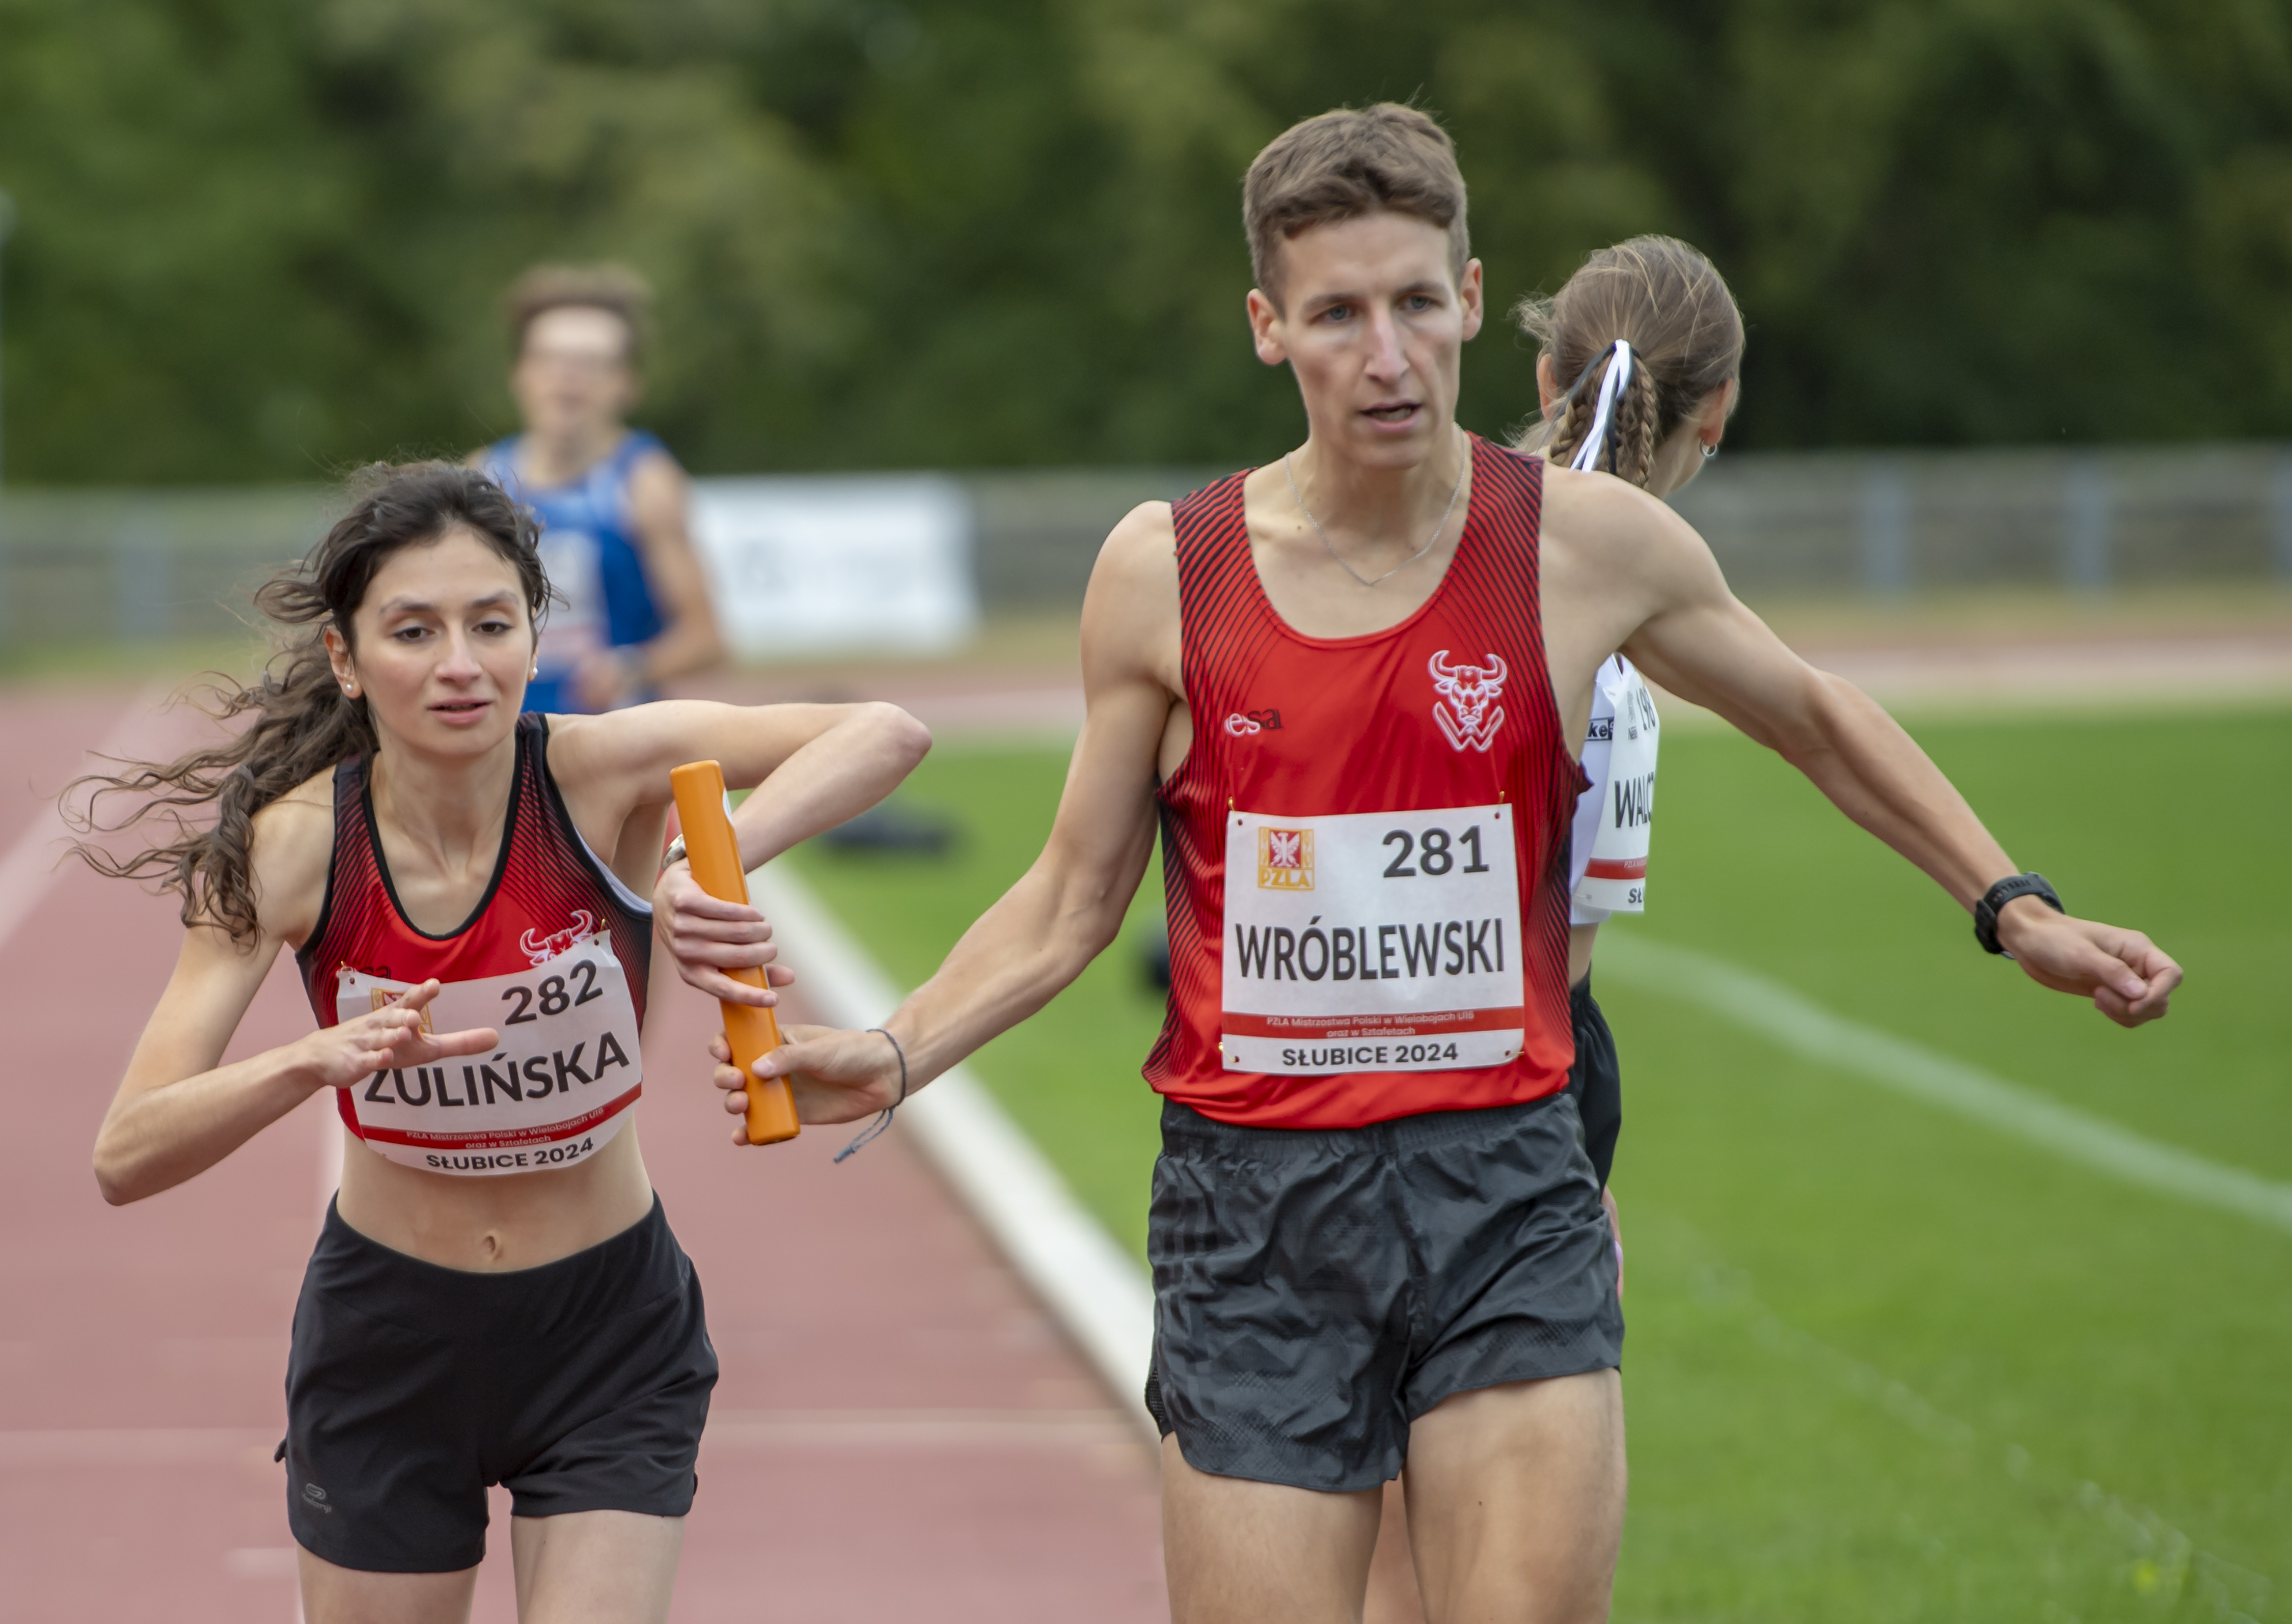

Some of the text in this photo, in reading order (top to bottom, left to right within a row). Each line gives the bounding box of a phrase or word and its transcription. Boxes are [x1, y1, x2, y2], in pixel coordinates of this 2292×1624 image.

[1381, 824, 1490, 878] 281
[1261, 868, 1310, 887] PZLA
[1235, 915, 1505, 981] WRÓBLEWSKI
[501, 958, 604, 1026] 282
[1266, 1016, 1290, 1026] PZLA
[1292, 1017, 1351, 1027] Mistrzostwa
[1352, 1015, 1382, 1025] Polski
[1394, 1012, 1456, 1025] Wielobojach
[1457, 1010, 1475, 1021] U16
[1326, 1029, 1349, 1038] oraz
[1361, 1026, 1416, 1037] Sztafetach
[1282, 1042, 1458, 1066] SŁUBICE 2024
[406, 1131, 429, 1140] PZLA
[429, 1133, 487, 1141] Mistrzostwa
[488, 1131, 516, 1139] Polski
[529, 1115, 588, 1135] Wielobojach
[589, 1107, 604, 1119] U16
[426, 1137, 593, 1170] SŁUBICE 2024
[499, 1135, 552, 1148] Sztafetach
